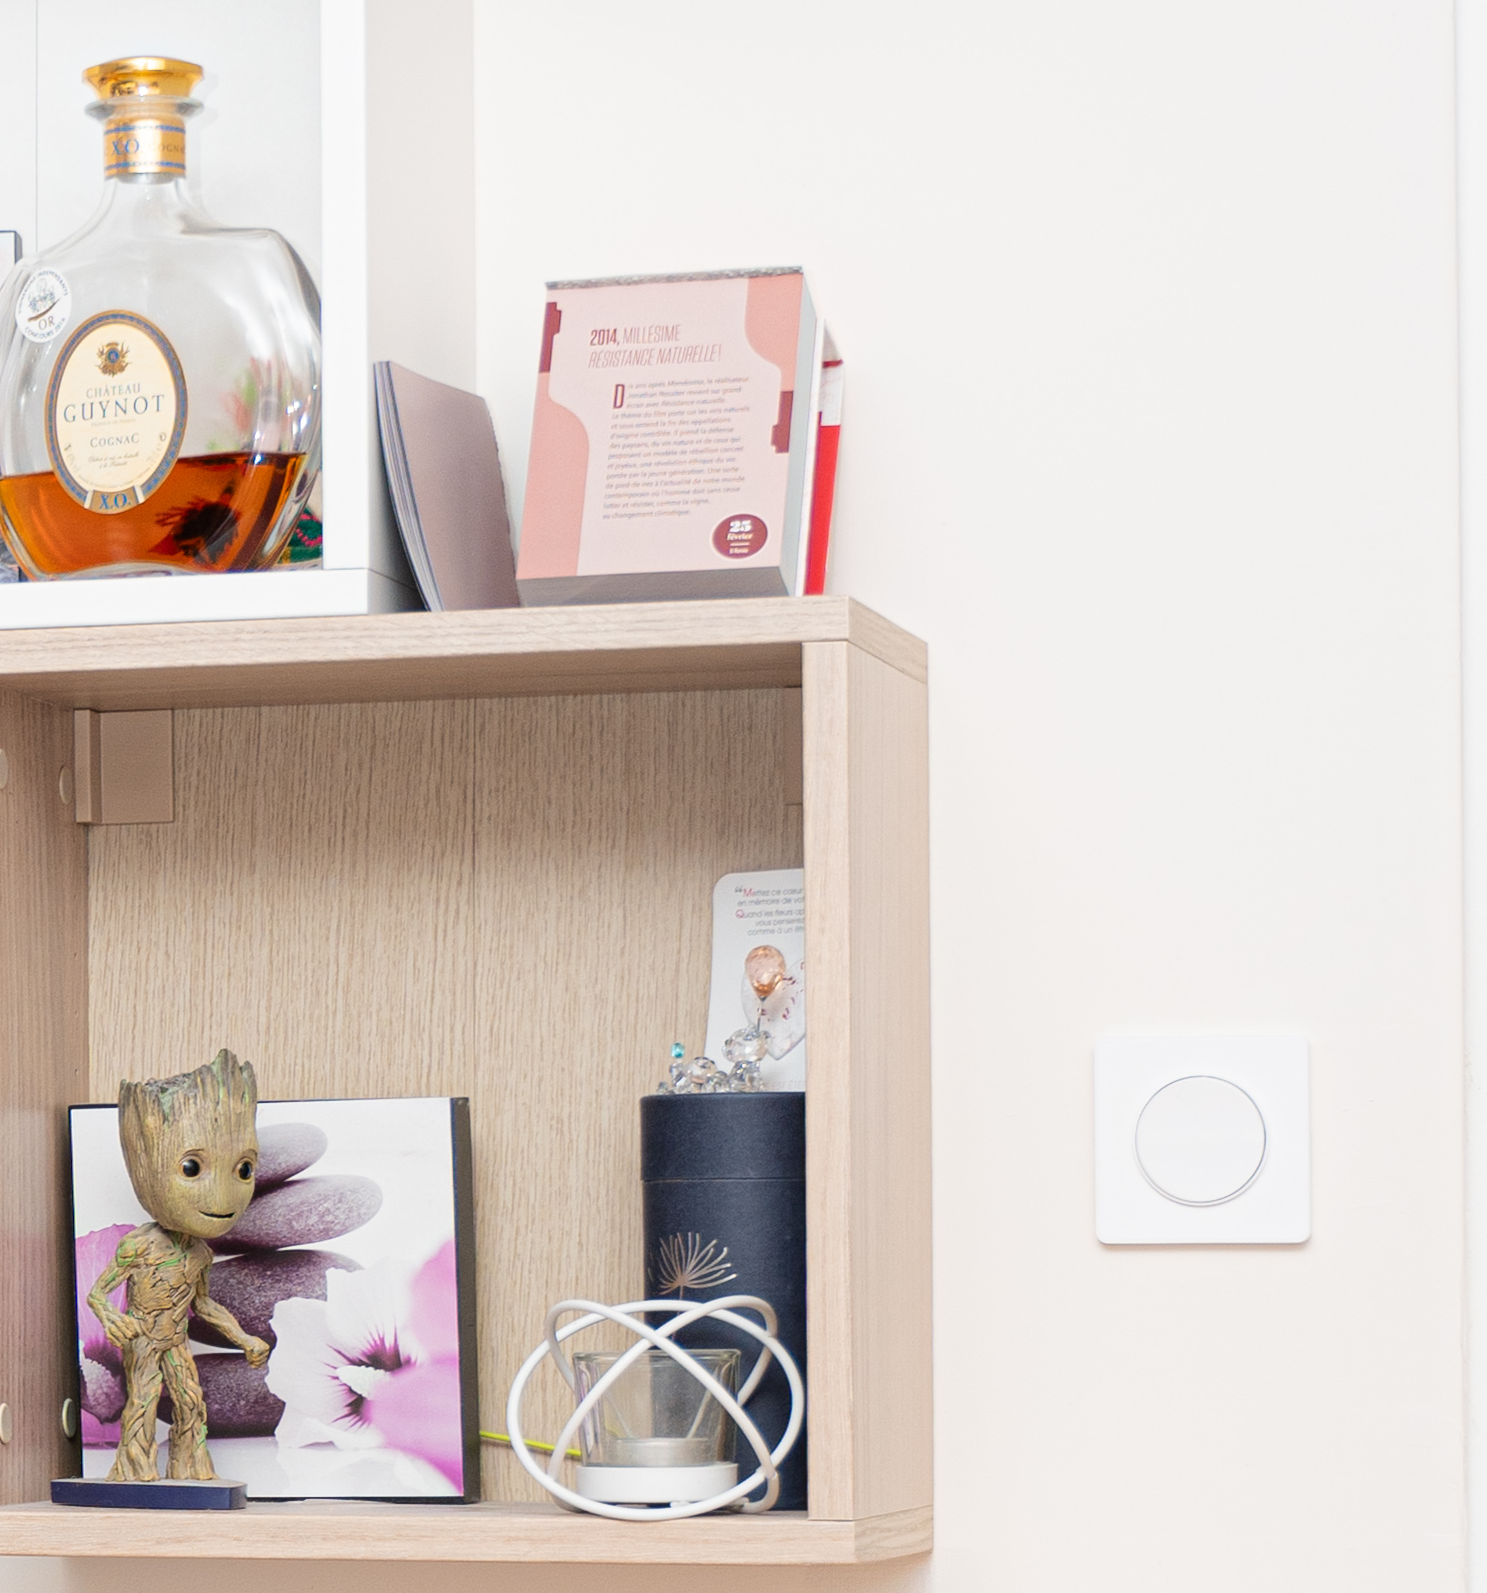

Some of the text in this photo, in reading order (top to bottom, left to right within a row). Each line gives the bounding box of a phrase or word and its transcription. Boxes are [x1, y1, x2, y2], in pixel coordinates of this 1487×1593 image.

[37, 316, 55, 331] OR
[590, 324, 681, 346] 2014, MILLÉSIME
[63, 394, 165, 422] GUYNOT
[90, 433, 140, 448] COGNAC
[99, 493, 131, 510] X.O.
[728, 520, 753, 534] 25
